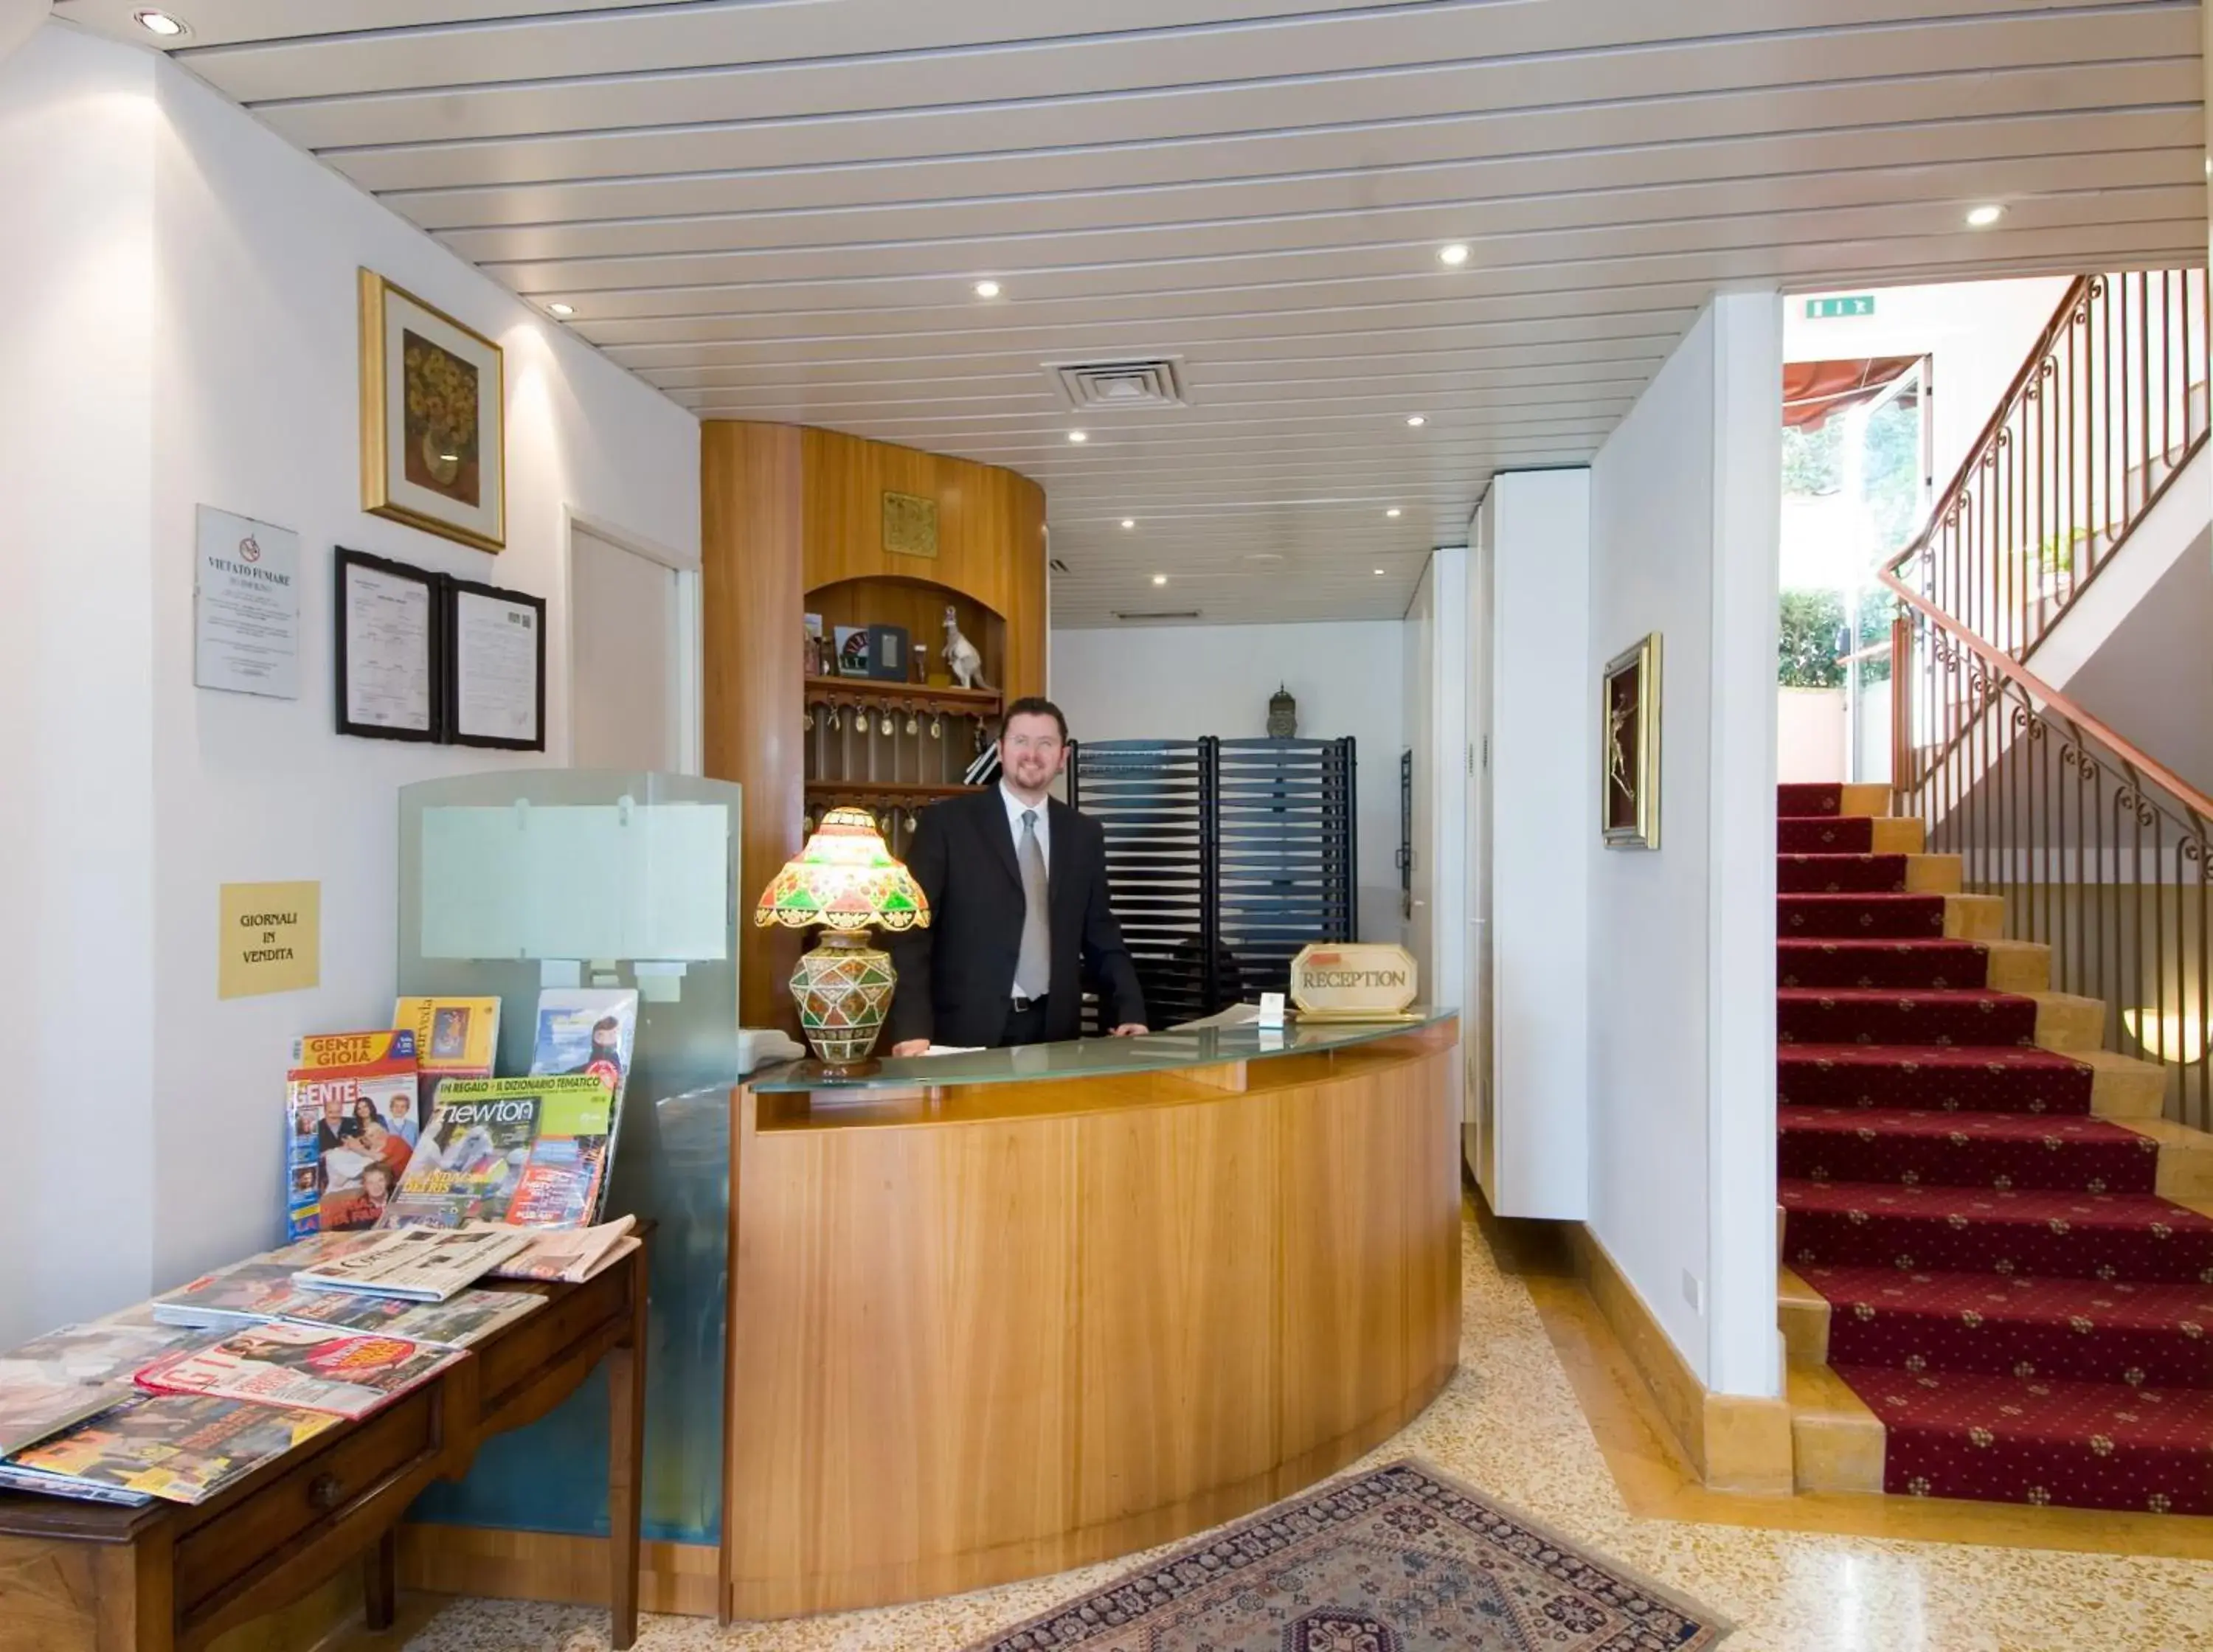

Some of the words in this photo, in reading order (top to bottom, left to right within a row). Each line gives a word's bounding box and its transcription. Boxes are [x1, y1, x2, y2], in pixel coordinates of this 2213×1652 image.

[208, 556, 252, 575] VIETATO
[253, 566, 291, 586] FUMARE
[240, 912, 297, 927] GIORNALI
[263, 931, 276, 943] IN
[243, 948, 294, 963] VENDITA
[1303, 970, 1405, 990] RECEPTION
[311, 1036, 372, 1052] GENTE
[317, 1050, 371, 1066] GIOIA
[453, 1080, 489, 1092] REGALO
[504, 1078, 555, 1092] DIZIONARIO
[556, 1077, 600, 1089] TEMATICO
[294, 1080, 357, 1107] GENTE
[440, 1100, 533, 1123] newton
